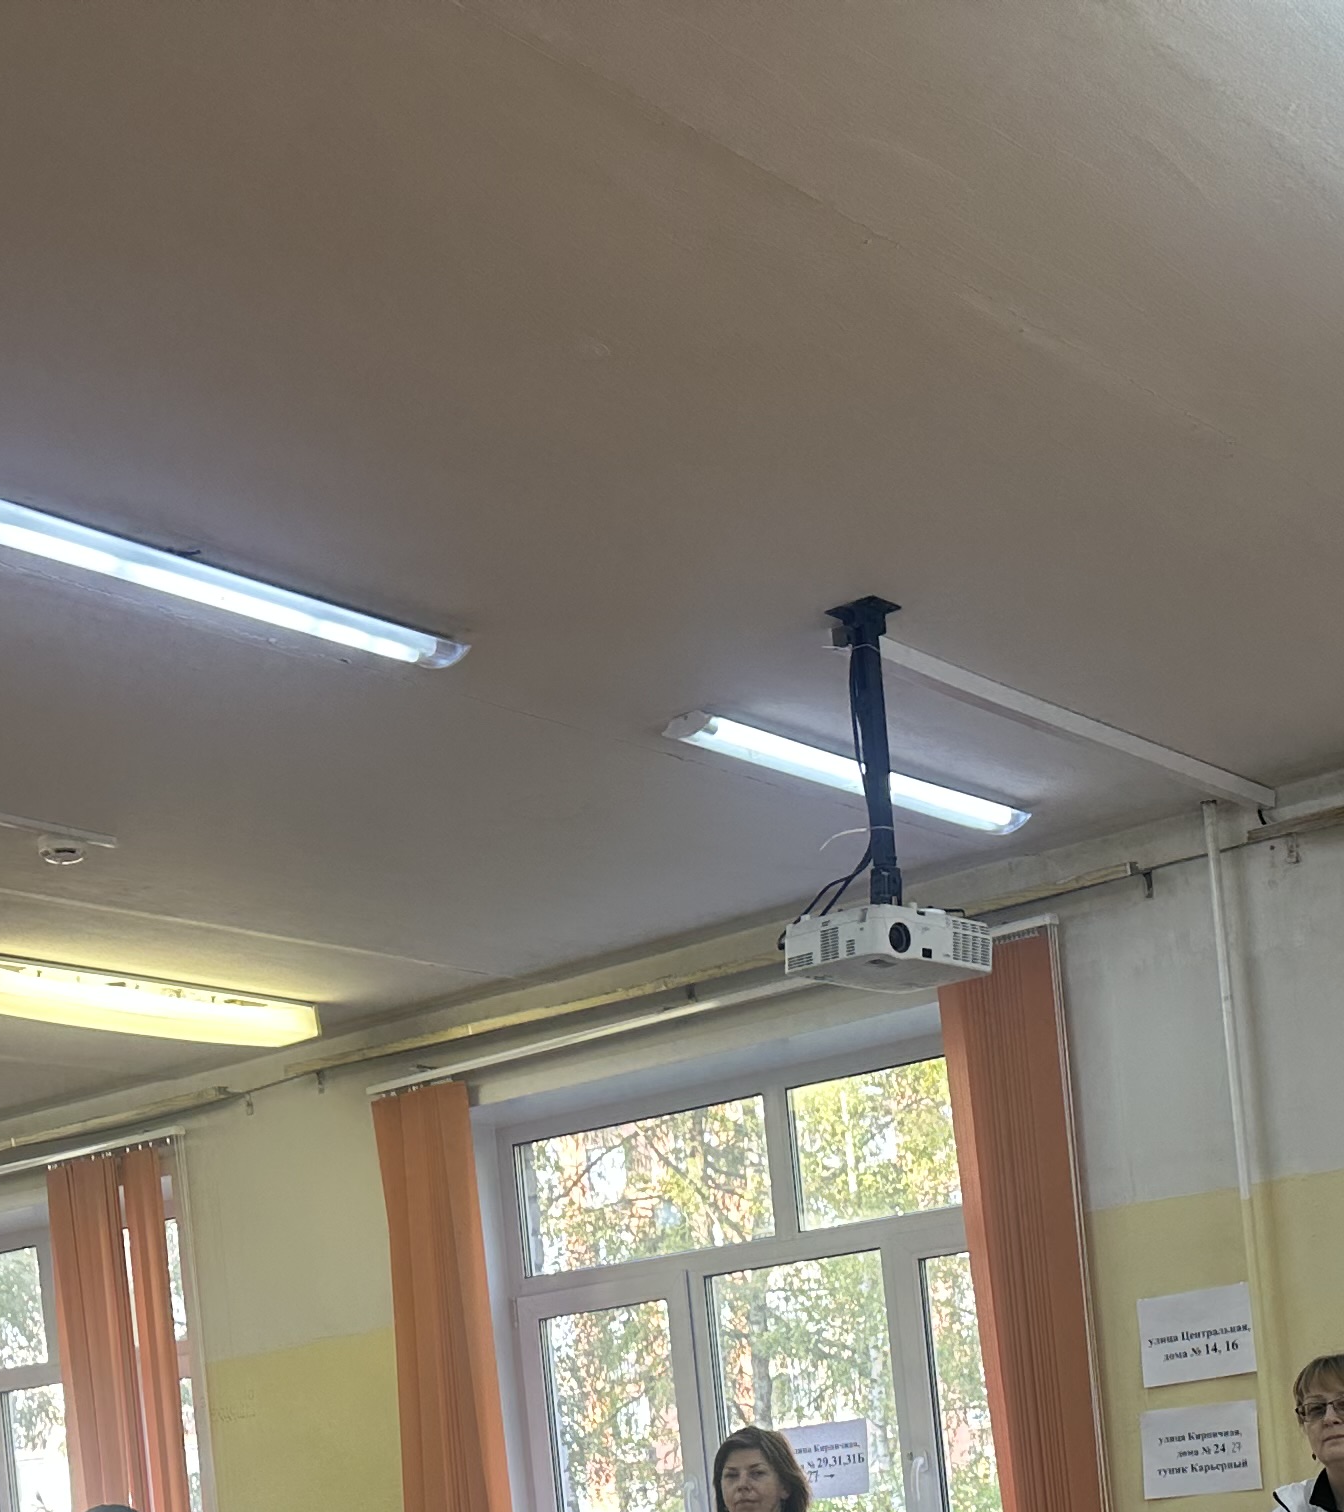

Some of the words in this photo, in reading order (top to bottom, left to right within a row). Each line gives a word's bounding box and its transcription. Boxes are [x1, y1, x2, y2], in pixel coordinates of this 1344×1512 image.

[1148, 1335, 1179, 1348] улица
[1163, 1351, 1188, 1361] дома
[1205, 1342, 1222, 1355] 14,
[1225, 1339, 1239, 1351] 16
